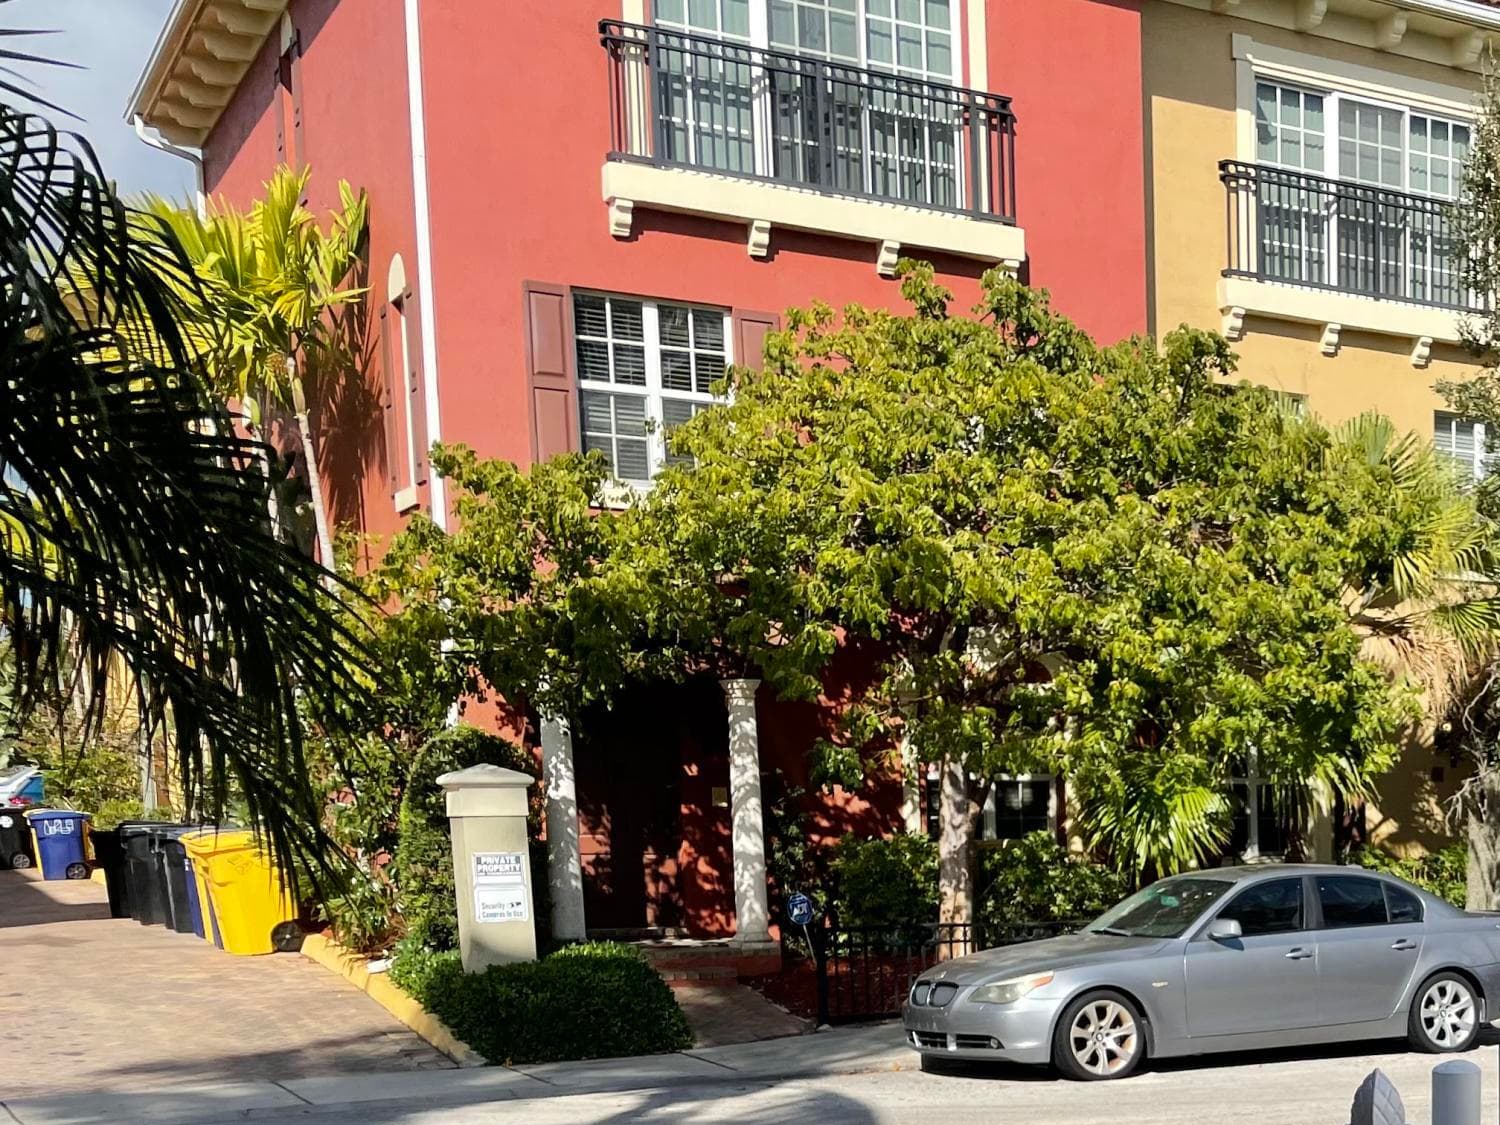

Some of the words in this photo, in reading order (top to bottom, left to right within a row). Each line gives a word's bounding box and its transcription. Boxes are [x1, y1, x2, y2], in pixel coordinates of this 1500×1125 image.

[481, 856, 516, 864] PRIVATE
[478, 864, 520, 872] PROPERTY
[482, 902, 505, 910] Security
